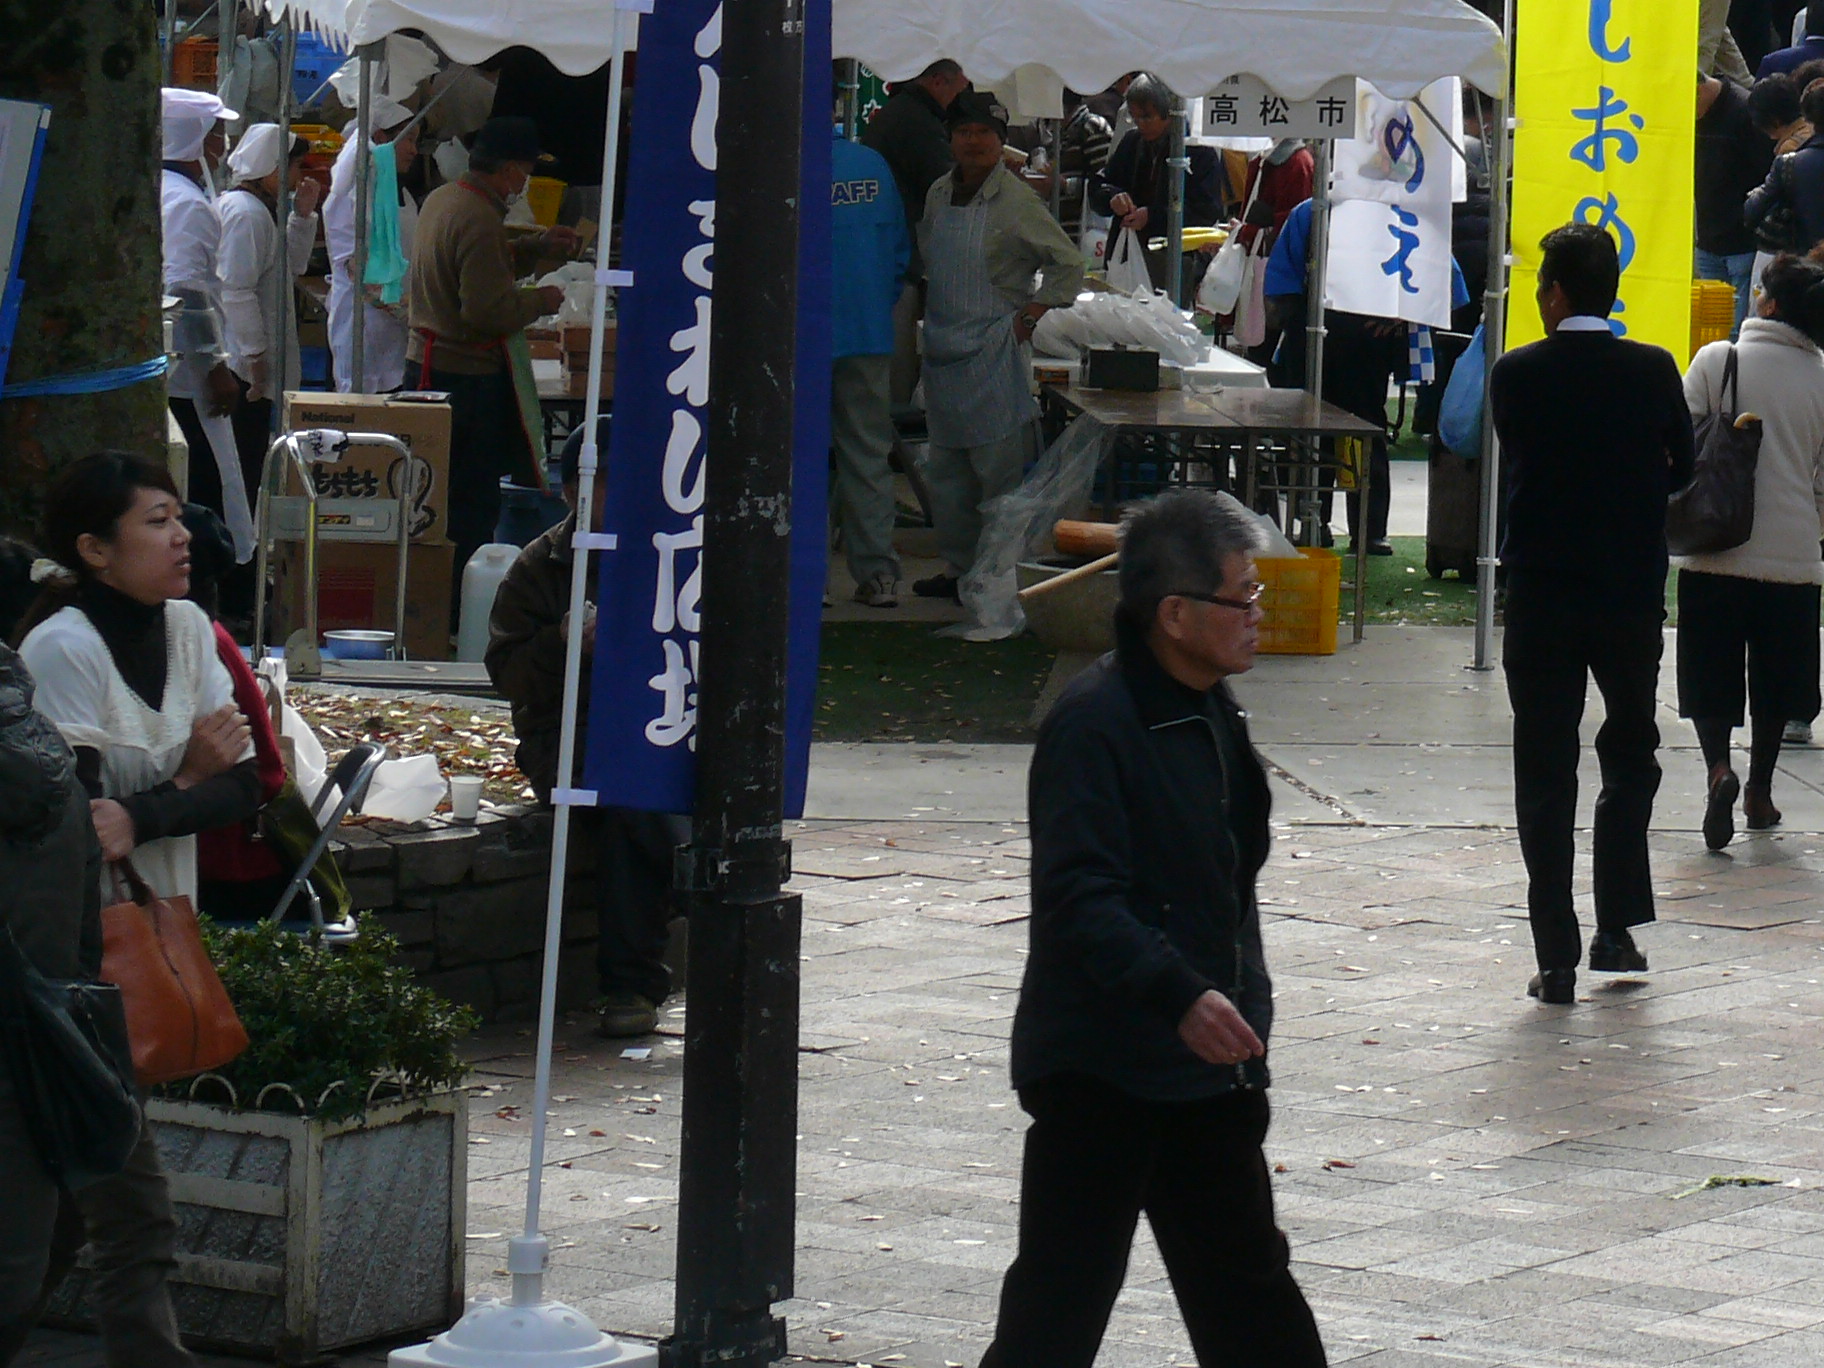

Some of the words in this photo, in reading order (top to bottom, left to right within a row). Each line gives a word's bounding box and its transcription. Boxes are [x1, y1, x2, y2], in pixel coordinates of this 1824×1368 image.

[1209, 94, 1347, 127] 高松市
[831, 181, 879, 205] AFF
[302, 412, 354, 424] National
